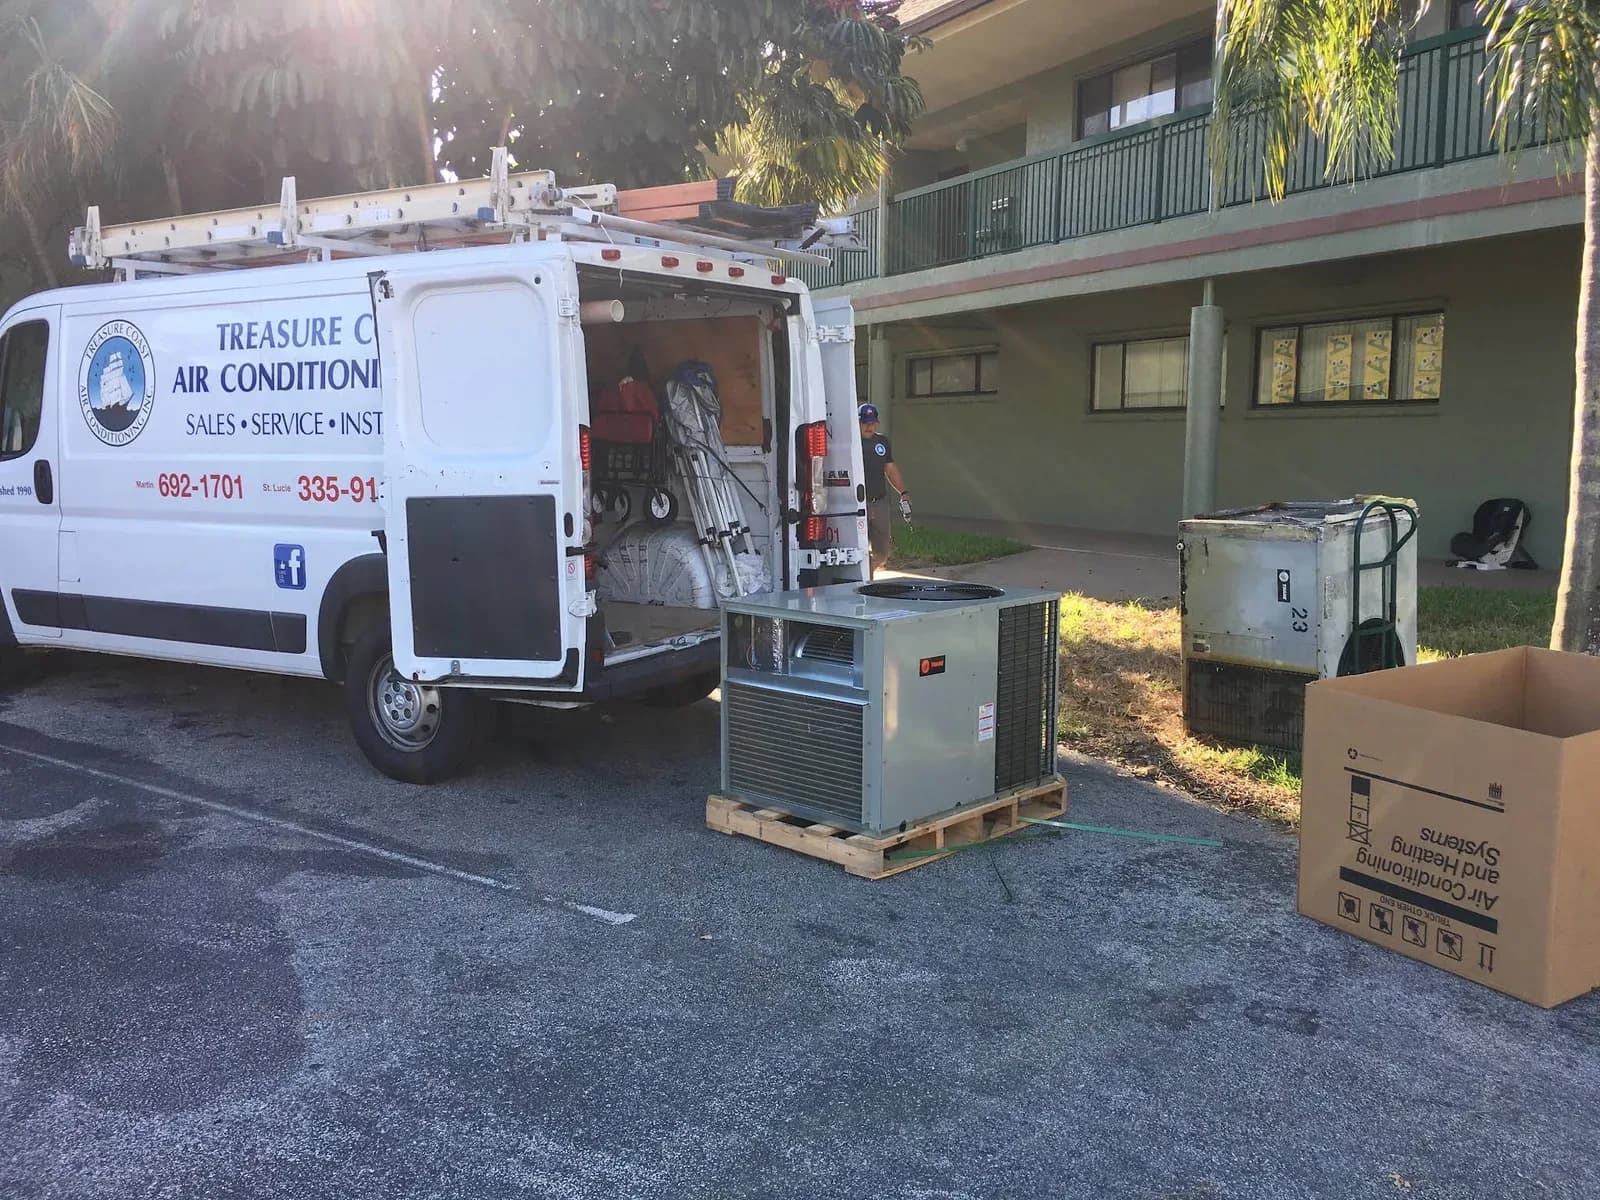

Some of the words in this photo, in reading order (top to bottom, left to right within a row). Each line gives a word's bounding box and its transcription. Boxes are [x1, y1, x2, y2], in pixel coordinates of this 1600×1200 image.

[86, 323, 125, 359] TREASURE
[126, 326, 150, 359] COAST
[216, 316, 342, 350] TREASURE
[354, 313, 373, 345] C
[172, 365, 209, 393] AIR
[220, 359, 382, 393] CONDITIONI
[80, 385, 88, 406] AIR
[86, 409, 144, 443] CONDITIONING
[186, 412, 236, 436] SALES
[251, 411, 324, 435] SERVICE
[341, 411, 383, 435] INST
[16, 486, 32, 496] 1990
[135, 481, 154, 489] Martin
[158, 473, 243, 499] 692-1701
[262, 483, 272, 492] St.
[273, 484, 291, 492] Lucie
[298, 475, 376, 502] 335-91
[827, 527, 839, 543] 01
[1292, 607, 1308, 632] 23
[1390, 835, 1459, 876] Heating
[1420, 827, 1500, 866] Systems
[1356, 847, 1466, 901] Conditioning
[1461, 861, 1500, 884] and
[1380, 895, 1396, 906] END
[1396, 902, 1423, 916] OTHER
[1468, 888, 1499, 911] Air
[1424, 909, 1451, 927] TRUCK
